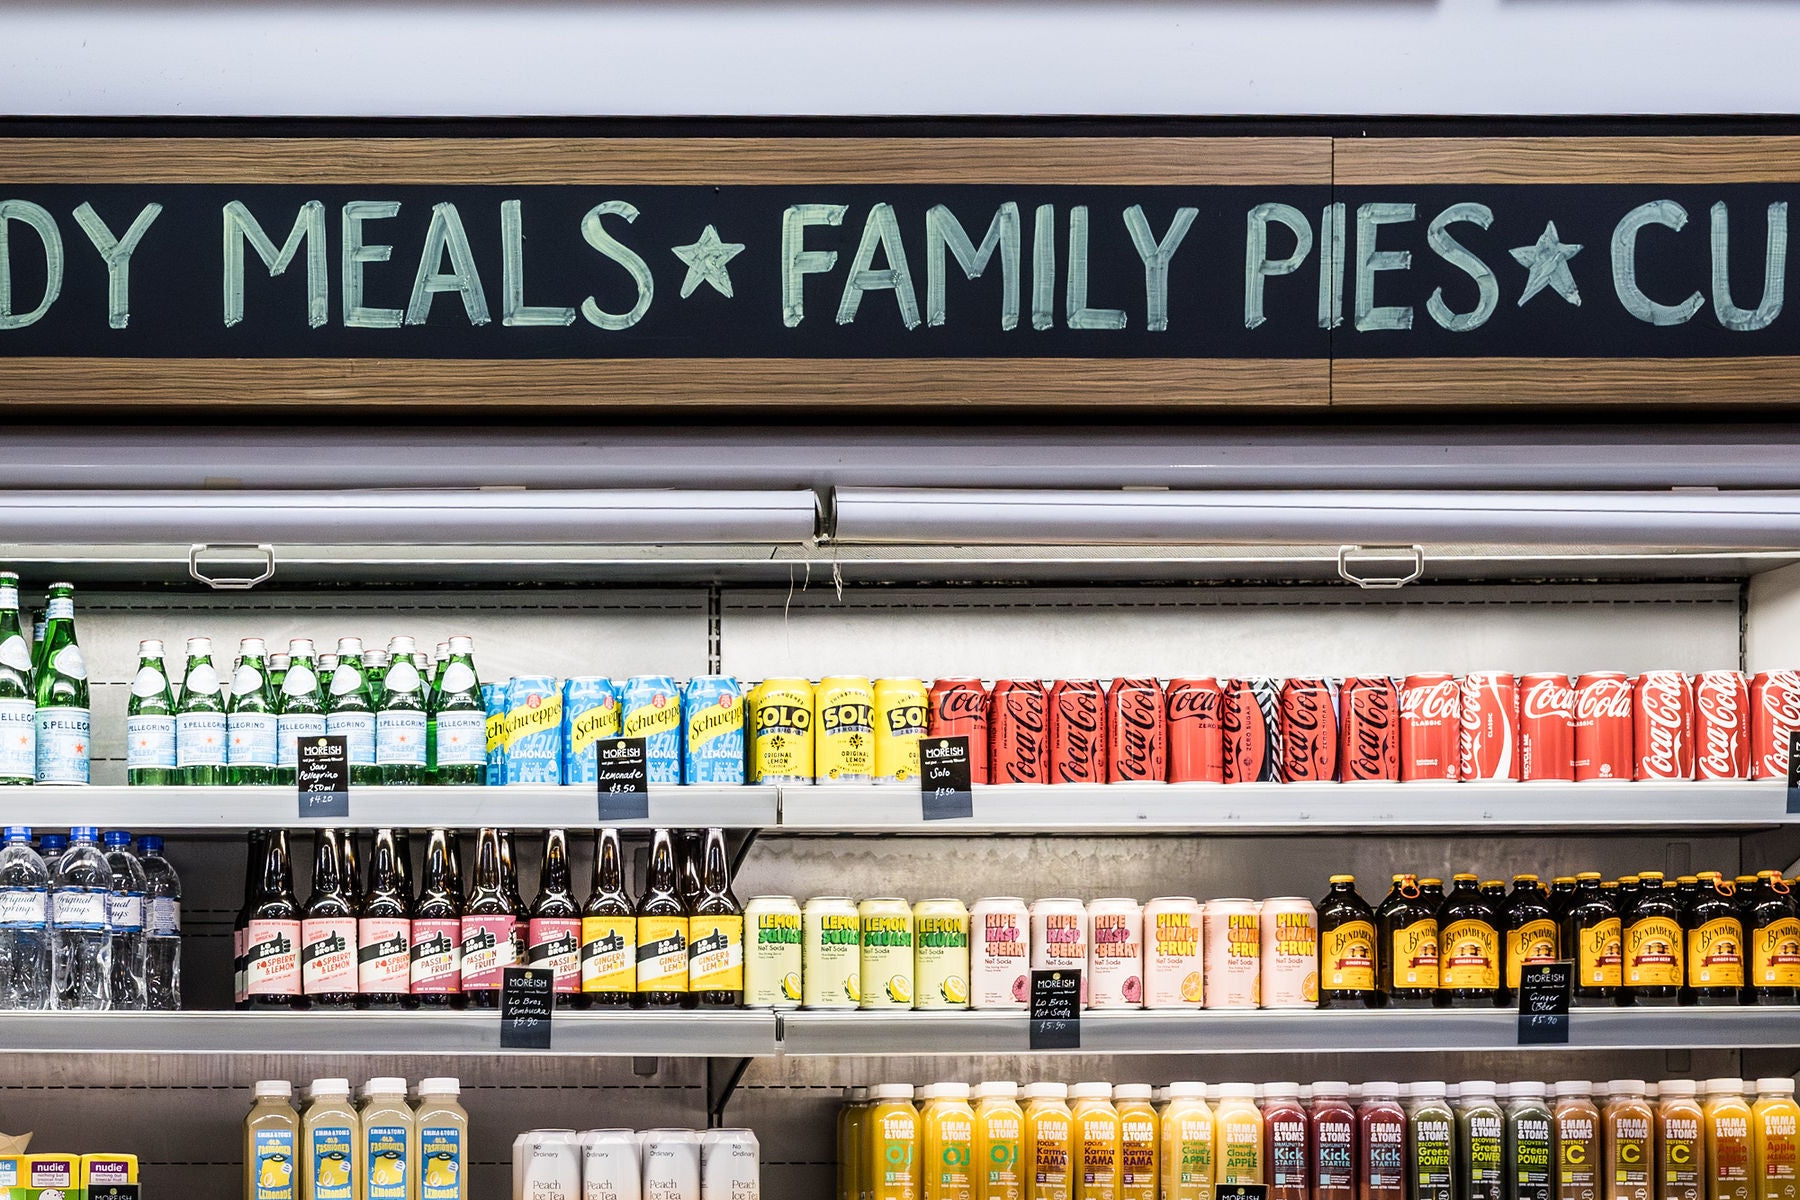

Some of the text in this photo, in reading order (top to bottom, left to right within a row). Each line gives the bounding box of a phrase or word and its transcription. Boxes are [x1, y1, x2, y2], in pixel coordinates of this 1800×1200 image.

[223, 199, 653, 331] MEALS
[781, 201, 1199, 332] FAMILY
[1245, 201, 1499, 332] PIES
[1611, 199, 1787, 331] CU
[756, 706, 809, 730] SOLO
[304, 746, 342, 756] MOREISH
[602, 747, 641, 758] MOREISH
[926, 747, 964, 758] MOREISH
[299, 769, 339, 783] Pellegrino
[600, 769, 643, 780] Lemonade
[929, 767, 950, 779] Solo
[609, 783, 636, 797] $3.50
[758, 914, 799, 929] LEMON
[864, 917, 907, 932] LEMON
[985, 913, 1016, 928] RIPE
[1095, 914, 1125, 928] RIPE
[1156, 913, 1191, 928] PINK
[864, 931, 912, 947] SQUASH
[985, 928, 1020, 942] RASP
[1095, 928, 1130, 943] RASP
[1156, 927, 1199, 942] GRAPE
[1440, 927, 1495, 955] BUNDABERG
[271, 962, 295, 974] LEMON
[327, 960, 350, 972] LEMON
[431, 962, 452, 974] FRUIT
[475, 959, 496, 971] FRUIT
[509, 979, 547, 988] MOREISH
[1527, 973, 1564, 983] MOREISH
[1037, 979, 1075, 989] MOREISH
[508, 997, 520, 1005] Lo
[1035, 998, 1047, 1007] Lo
[988, 1119, 1018, 1129] EMMA
[1037, 1121, 1067, 1131] EMMA
[1181, 1121, 1211, 1130] EMMA
[1320, 1122, 1350, 1132] EMMA
[1417, 1121, 1448, 1131] EMMA
[1561, 1119, 1592, 1129] EMMA
[990, 1144, 1018, 1164] OJ
[1181, 1146, 1211, 1157] Cloudy
[1320, 1148, 1350, 1160] Kick
[1418, 1147, 1449, 1156] Green
[1566, 1145, 1585, 1164] C
[1036, 1155, 1067, 1165] RAMA
[1181, 1155, 1211, 1165] APPLE
[1418, 1156, 1449, 1166] POWER
[37, 1163, 65, 1172] nudie
[95, 1163, 123, 1172] nudie
[532, 1179, 561, 1190] Peach
[649, 1179, 677, 1189] Peach
[532, 1191, 565, 1200] Ice Tea
[649, 1190, 682, 1200] Ice Tea
